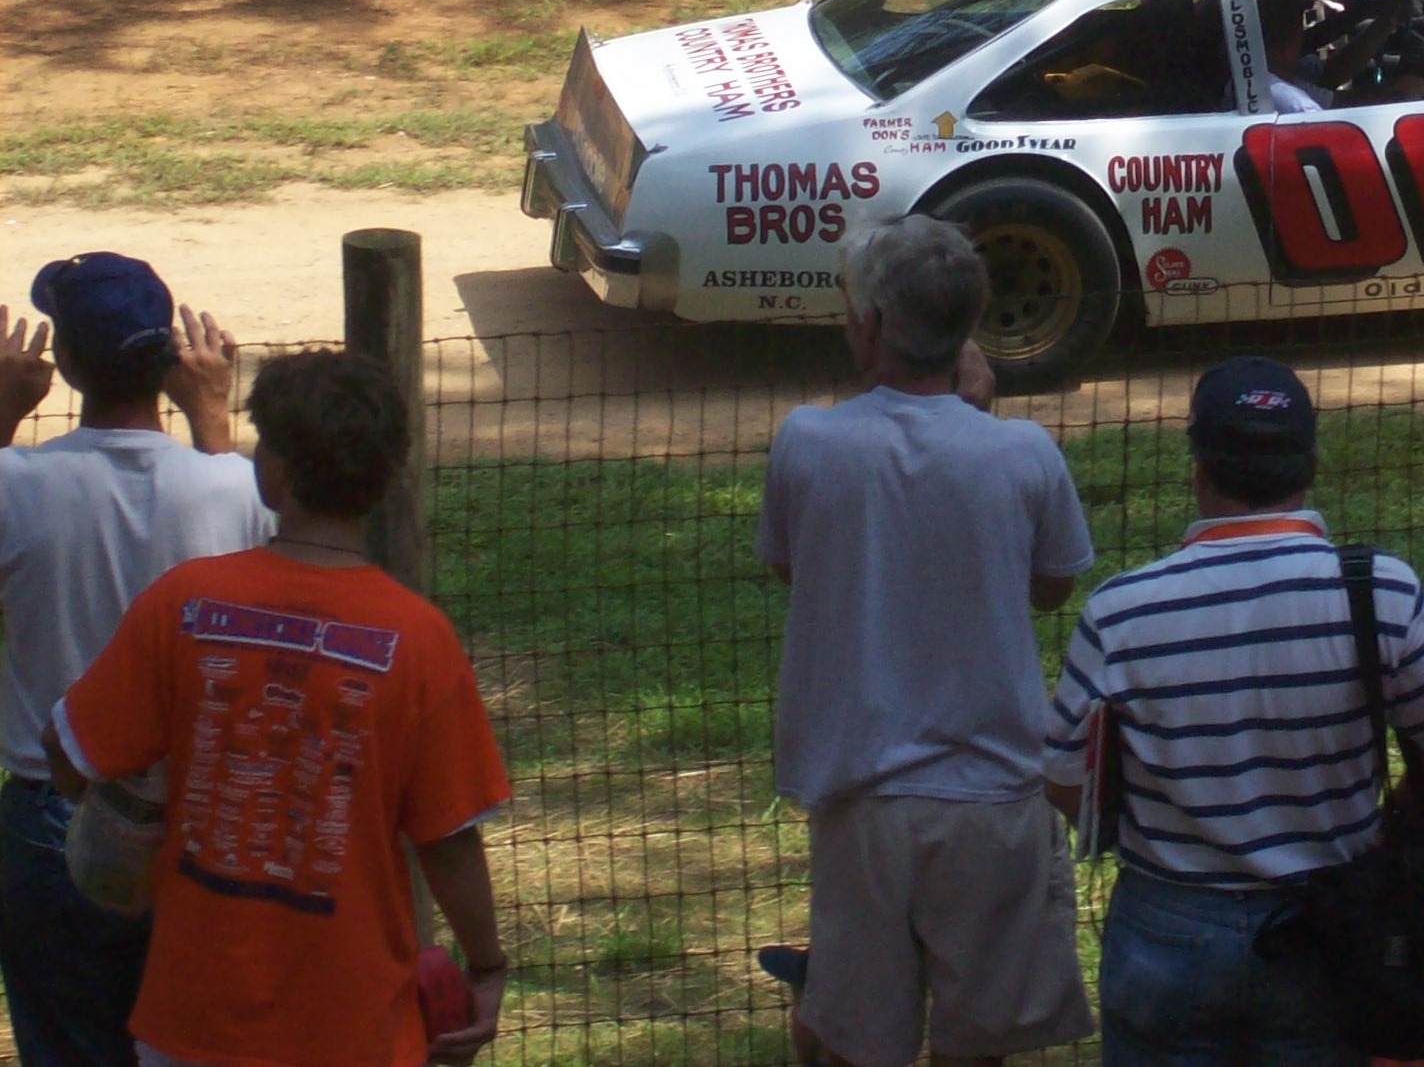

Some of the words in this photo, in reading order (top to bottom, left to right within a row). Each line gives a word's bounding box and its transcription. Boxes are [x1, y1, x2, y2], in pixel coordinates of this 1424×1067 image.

[675, 28, 733, 74] COUNTRY
[704, 80, 756, 122] HAM
[737, 51, 802, 112] BROTHERS
[863, 118, 912, 128] FARMER
[872, 129, 910, 140] DON'S
[910, 142, 946, 153] HAM
[956, 136, 1076, 153] GOODYEAR
[708, 161, 880, 203] THOMAS
[1107, 154, 1224, 194] COUNTRY
[1141, 196, 1213, 235] HAM
[758, 295, 806, 310] N.C.
